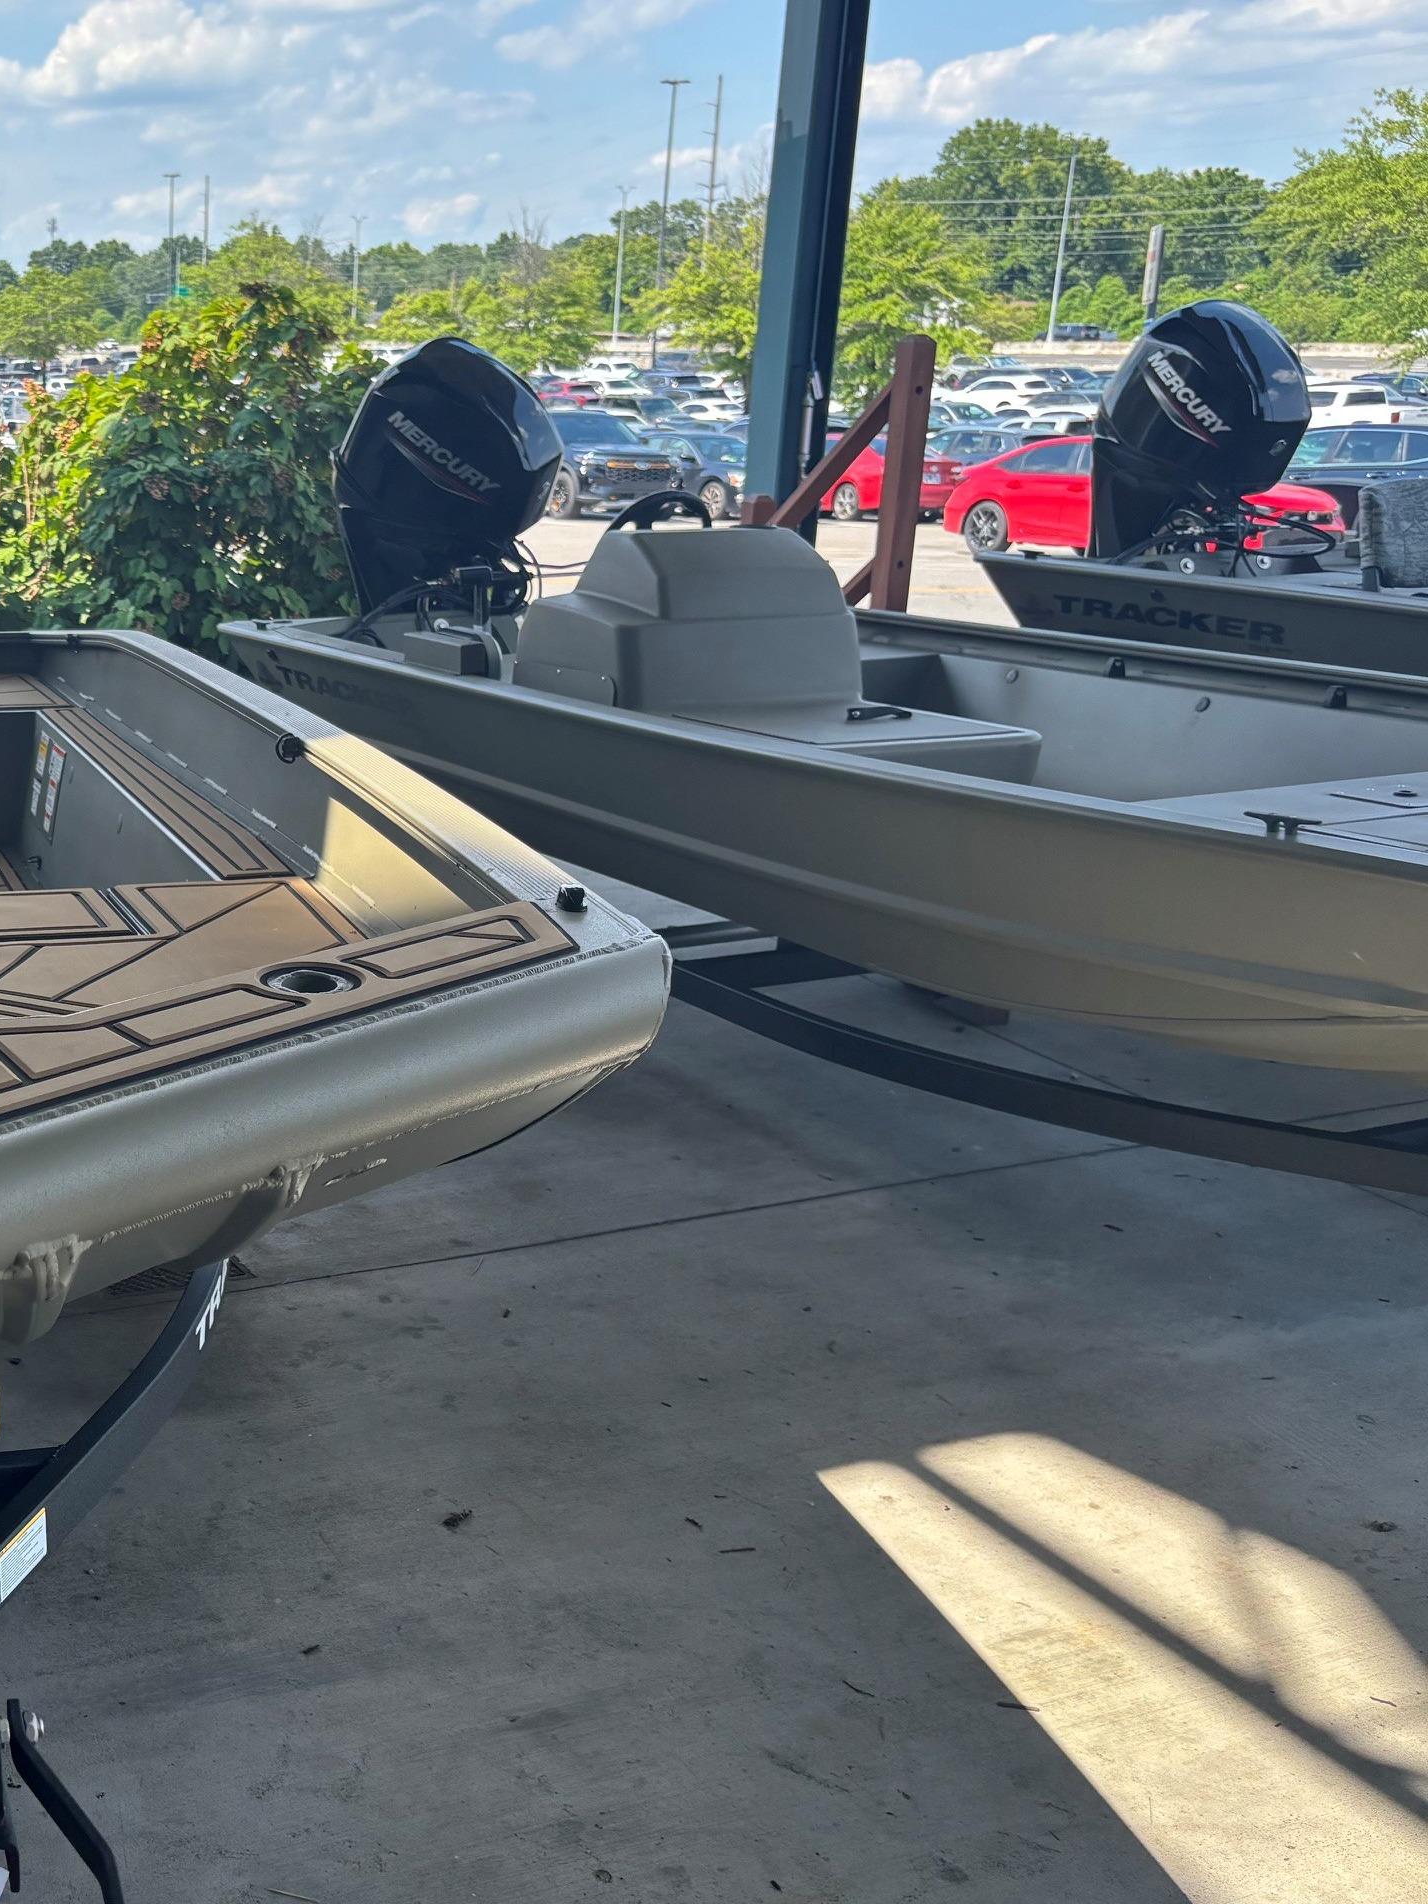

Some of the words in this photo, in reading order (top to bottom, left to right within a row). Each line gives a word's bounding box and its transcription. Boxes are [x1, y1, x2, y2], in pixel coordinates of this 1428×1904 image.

[1147, 351, 1232, 433] MERCURY
[387, 411, 501, 492] MERCURY
[1053, 593, 1286, 645] TRACKER
